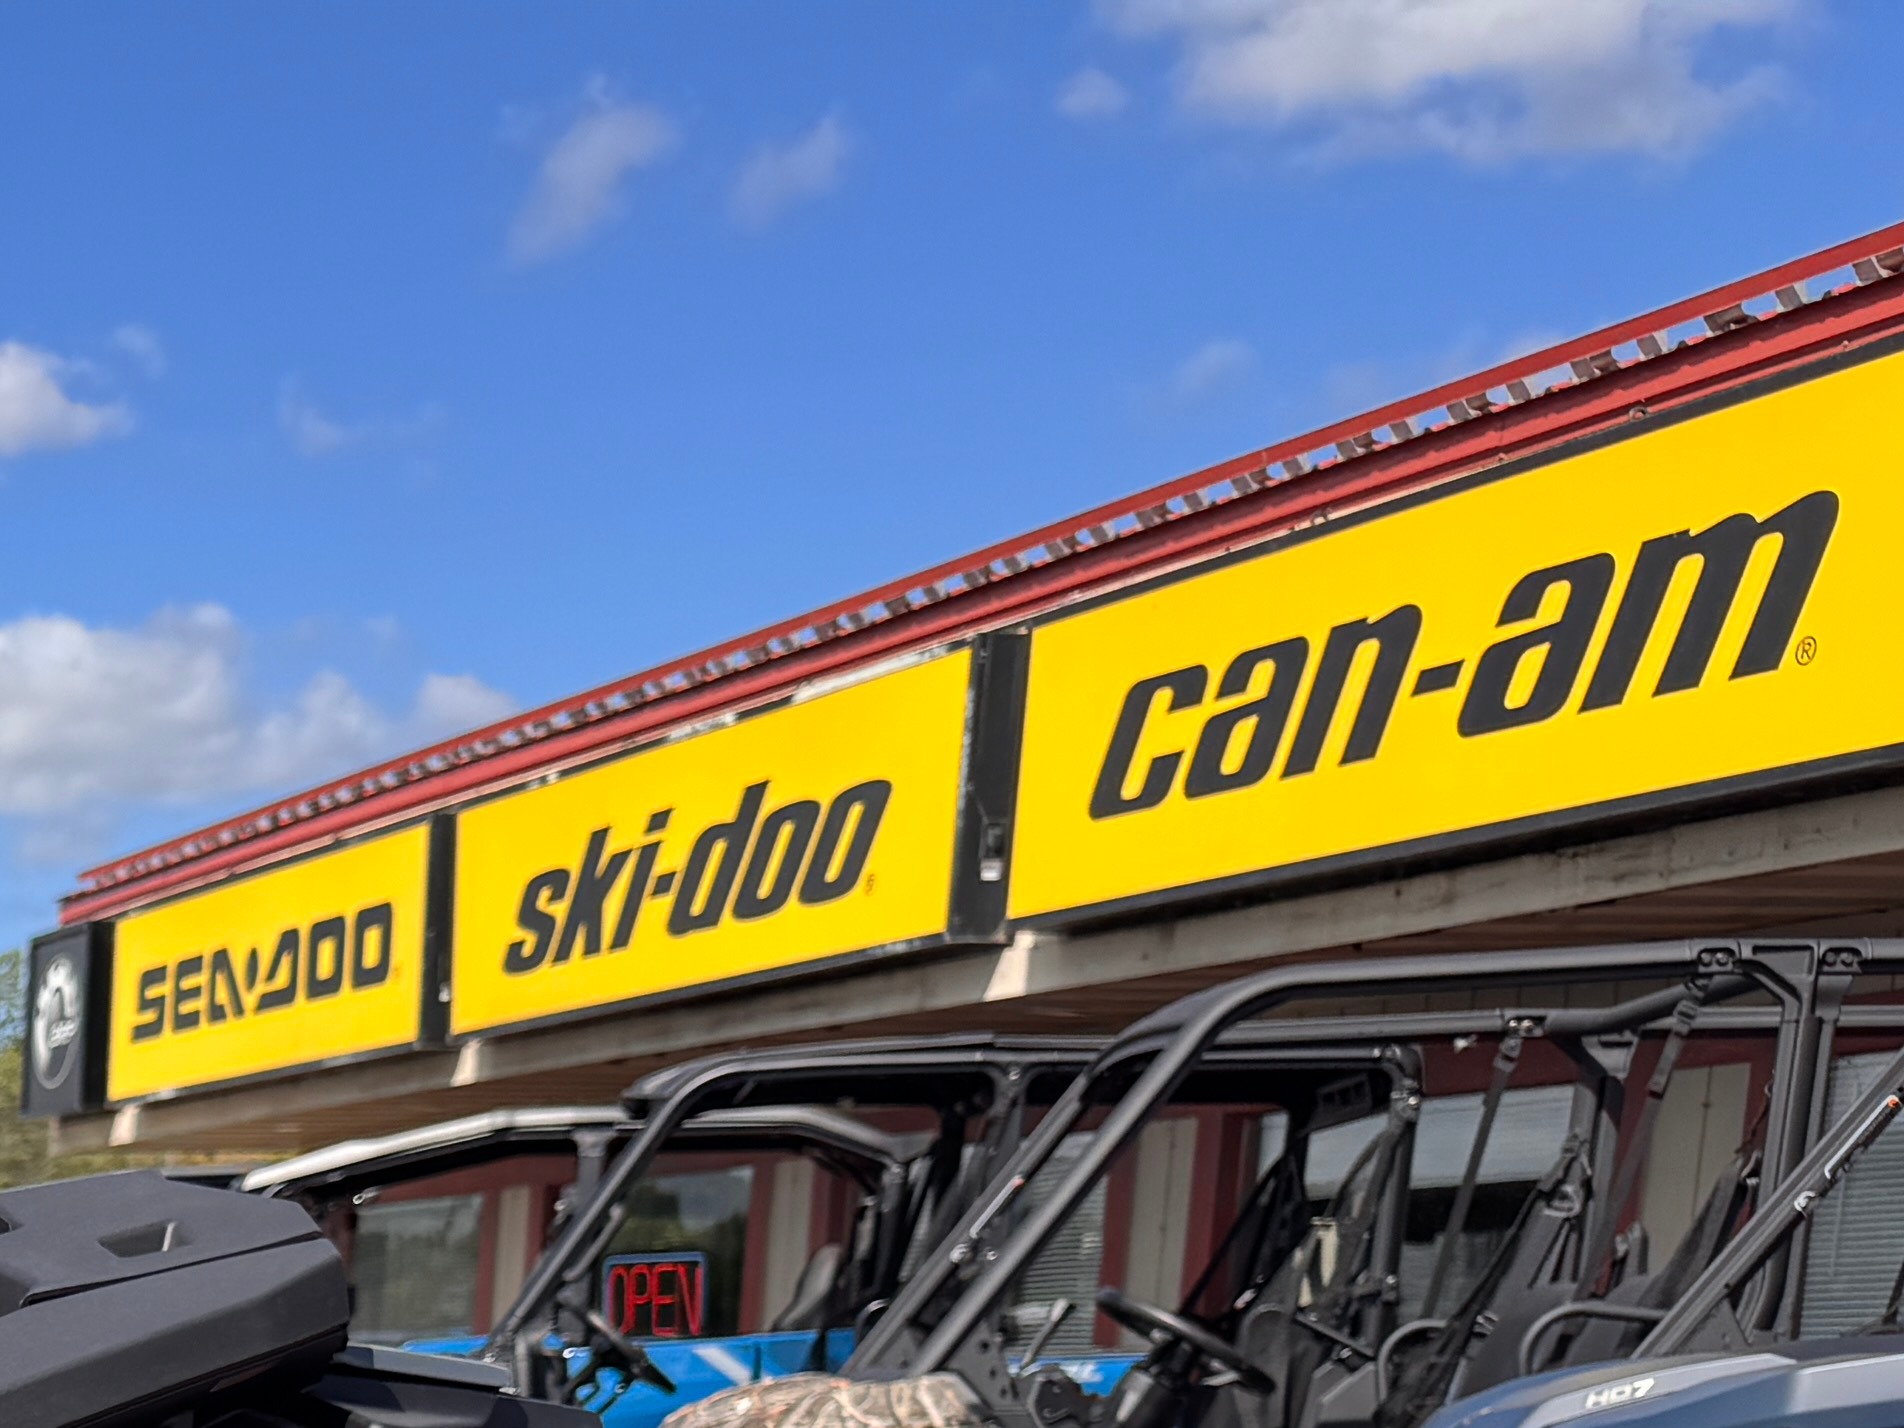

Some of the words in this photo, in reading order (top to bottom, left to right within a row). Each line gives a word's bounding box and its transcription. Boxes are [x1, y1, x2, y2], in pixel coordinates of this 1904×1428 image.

[1088, 489, 1840, 822] can-am
[502, 779, 893, 975] ski-doo
[607, 1262, 704, 1337] OPEN
